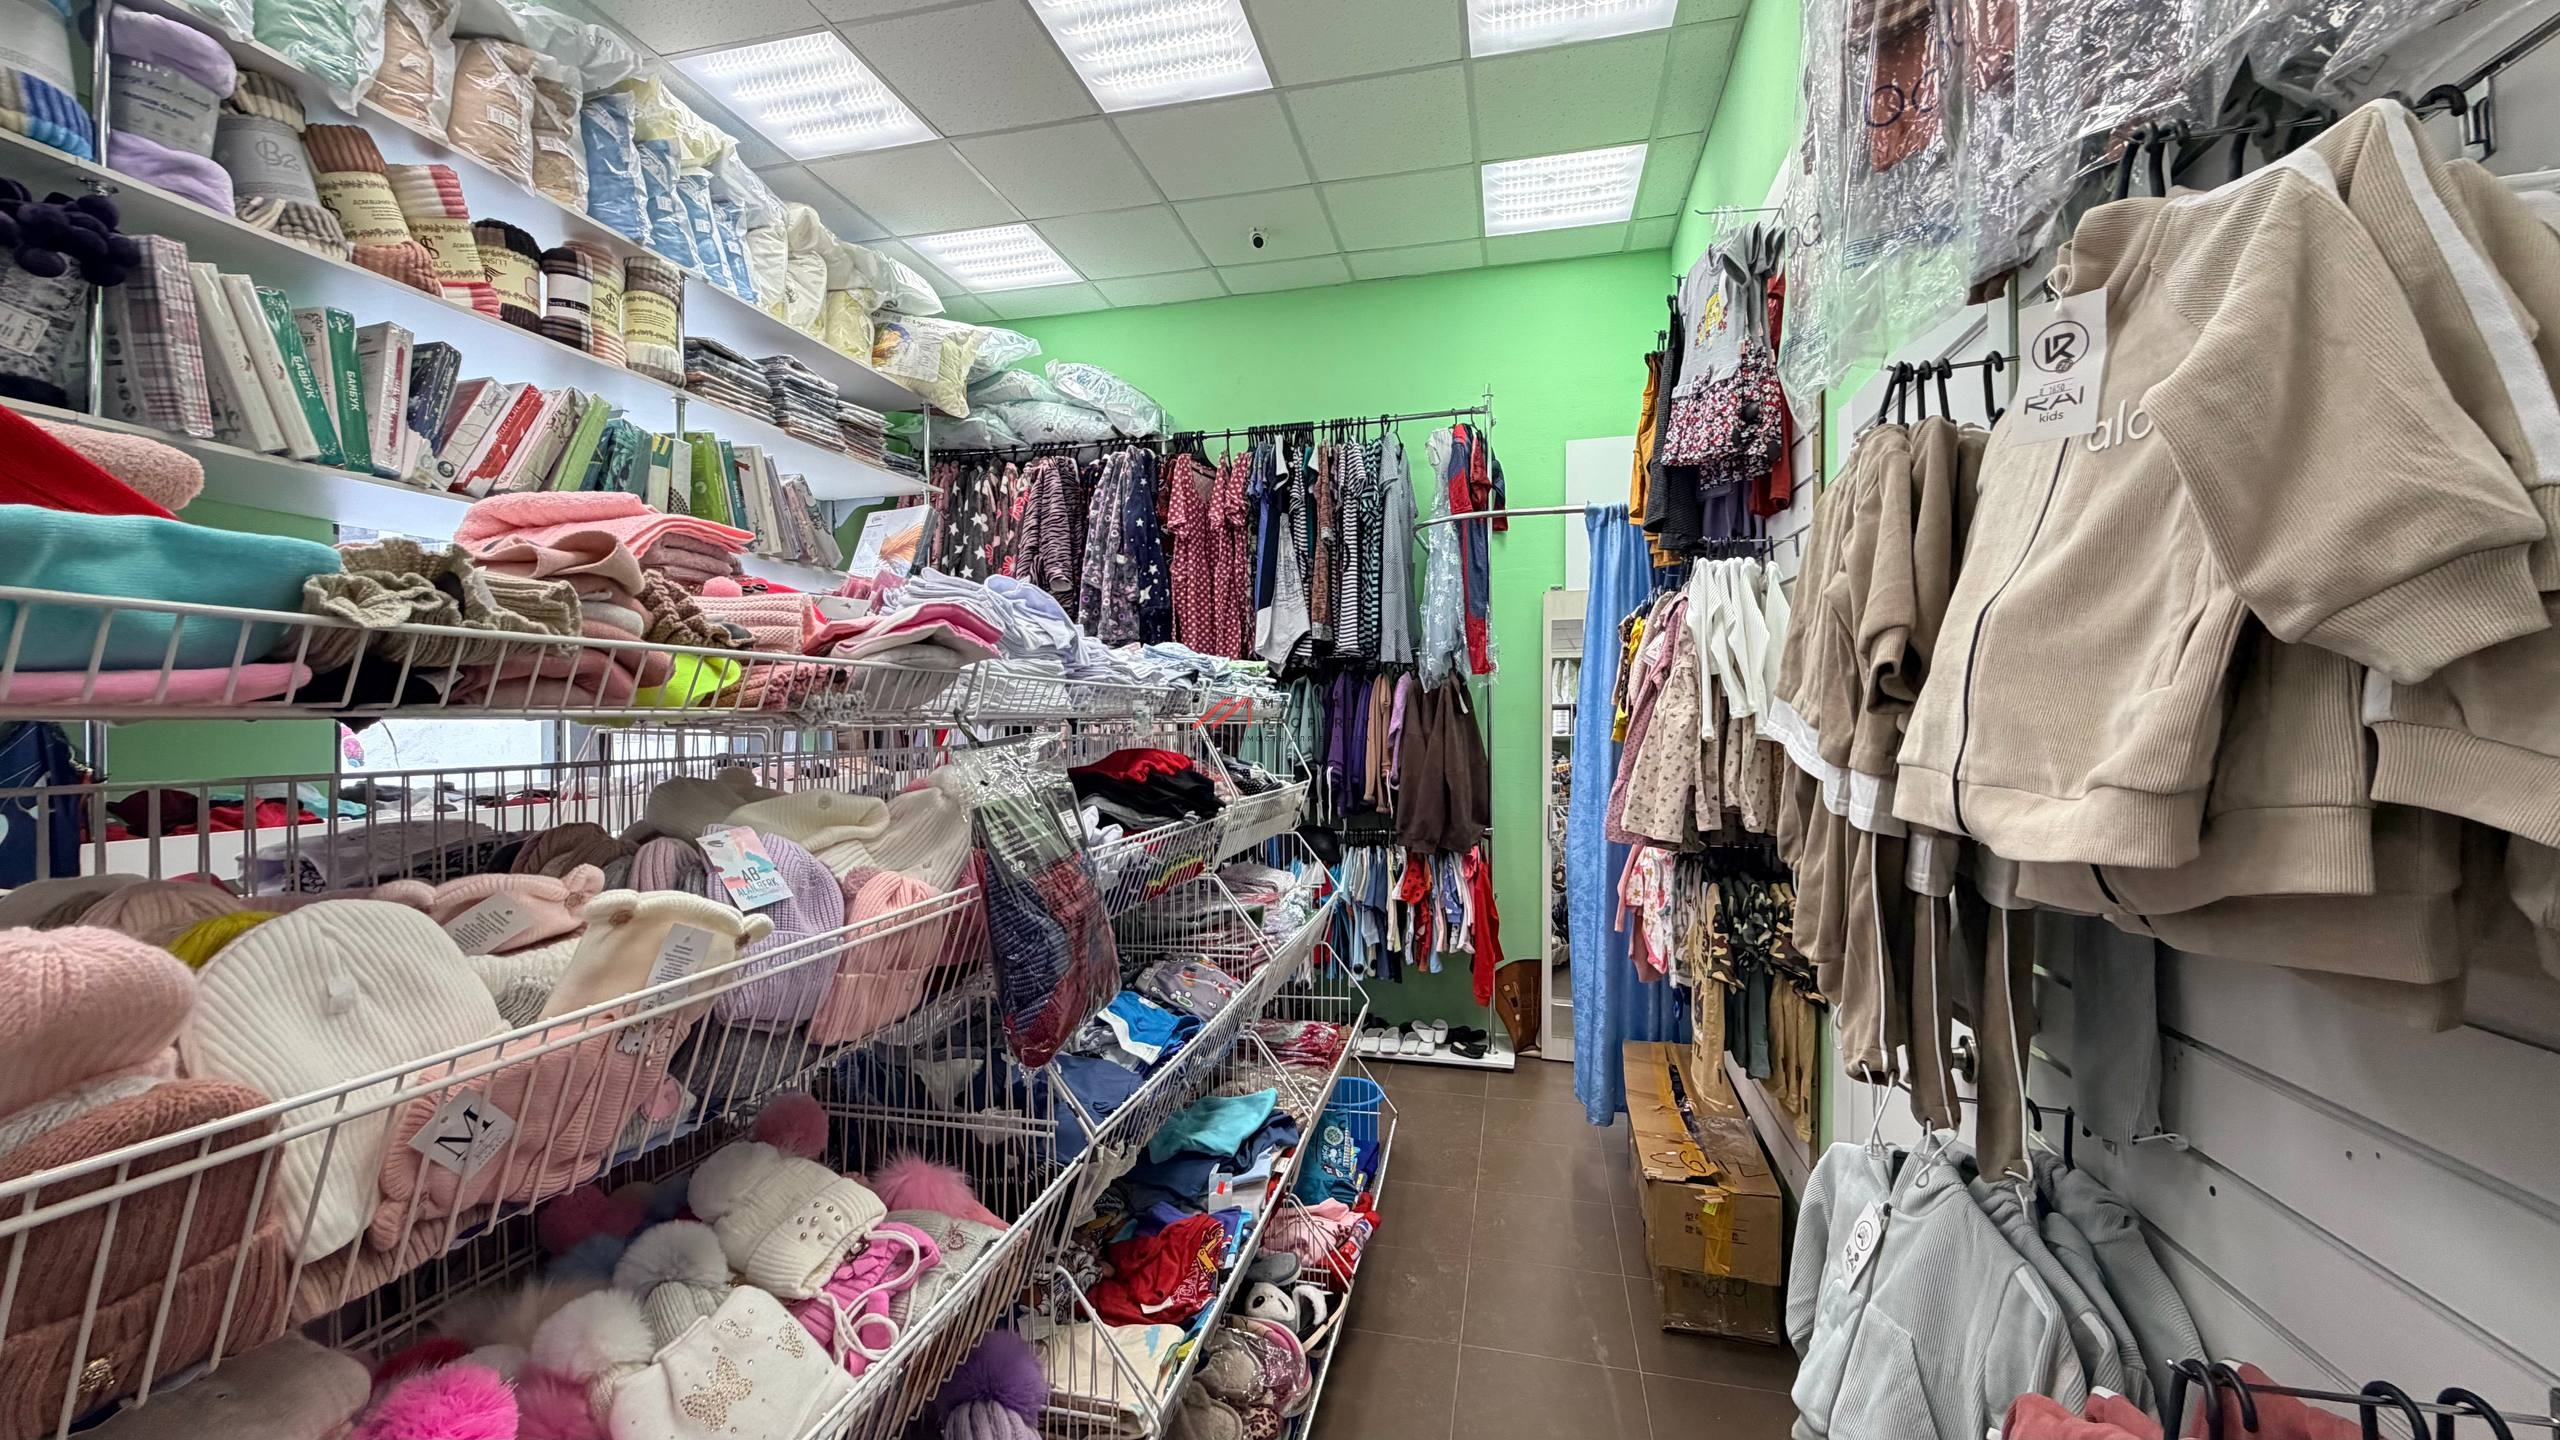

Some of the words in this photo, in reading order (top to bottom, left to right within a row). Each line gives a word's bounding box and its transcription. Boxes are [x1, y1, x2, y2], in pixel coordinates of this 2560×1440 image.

[292, 354, 317, 399] БАМБУК
[346, 370, 361, 412] БАМБУК
[2024, 385, 2084, 415] RAI
[2039, 410, 2064, 423] kids
[2086, 399, 2154, 452] alo
[741, 866, 761, 884] AB
[434, 1104, 496, 1161] M
